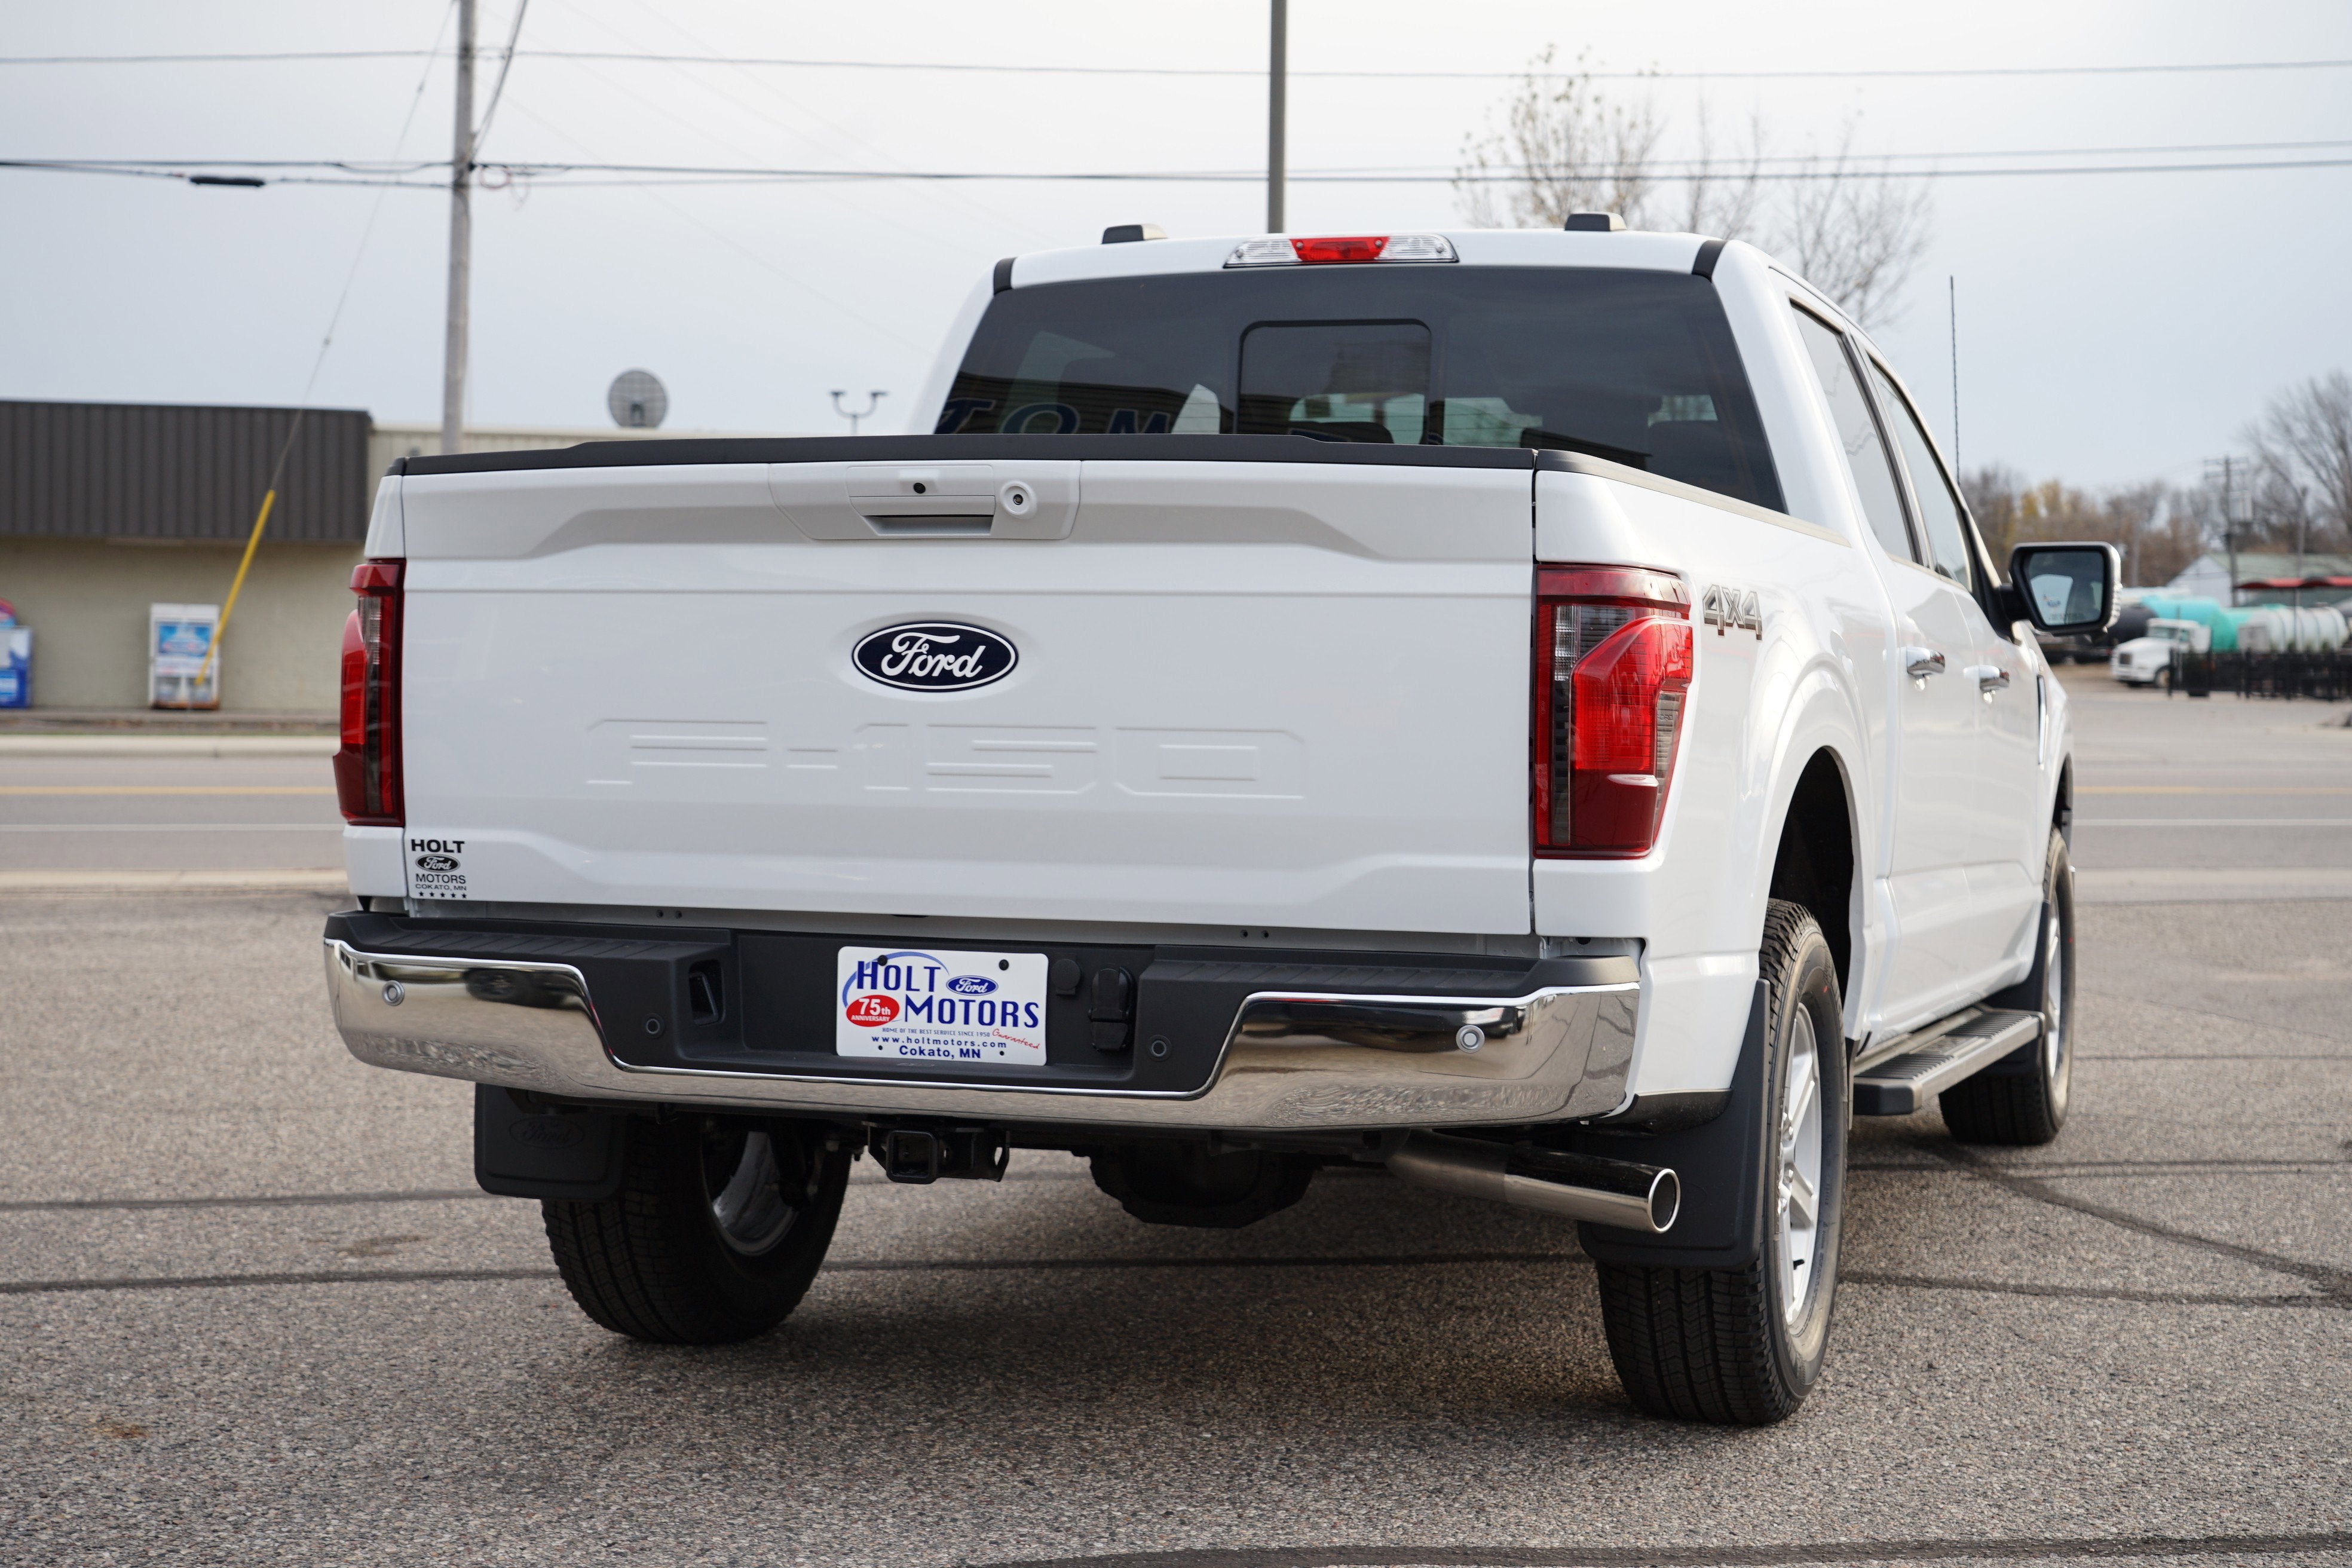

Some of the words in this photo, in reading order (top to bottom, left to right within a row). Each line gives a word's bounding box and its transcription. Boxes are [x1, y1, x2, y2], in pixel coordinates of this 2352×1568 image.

[881, 632, 986, 678] Ford
[586, 717, 1306, 801] F-150
[411, 838, 466, 853] HOLT
[423, 856, 452, 870] Ford
[415, 873, 467, 884] MOTORS
[856, 960, 941, 992] HOLT
[956, 977, 989, 993] Ford
[859, 998, 892, 1016] 75th
[904, 993, 1040, 1028] MOTORS
[850, 1014, 891, 1022] ANNIVERSARY
[871, 1036, 1007, 1049] www.holtmotors.com
[991, 1028, 1041, 1050] Guaranteed
[899, 1045, 955, 1060] Cokato,
[959, 1048, 981, 1059] MN
